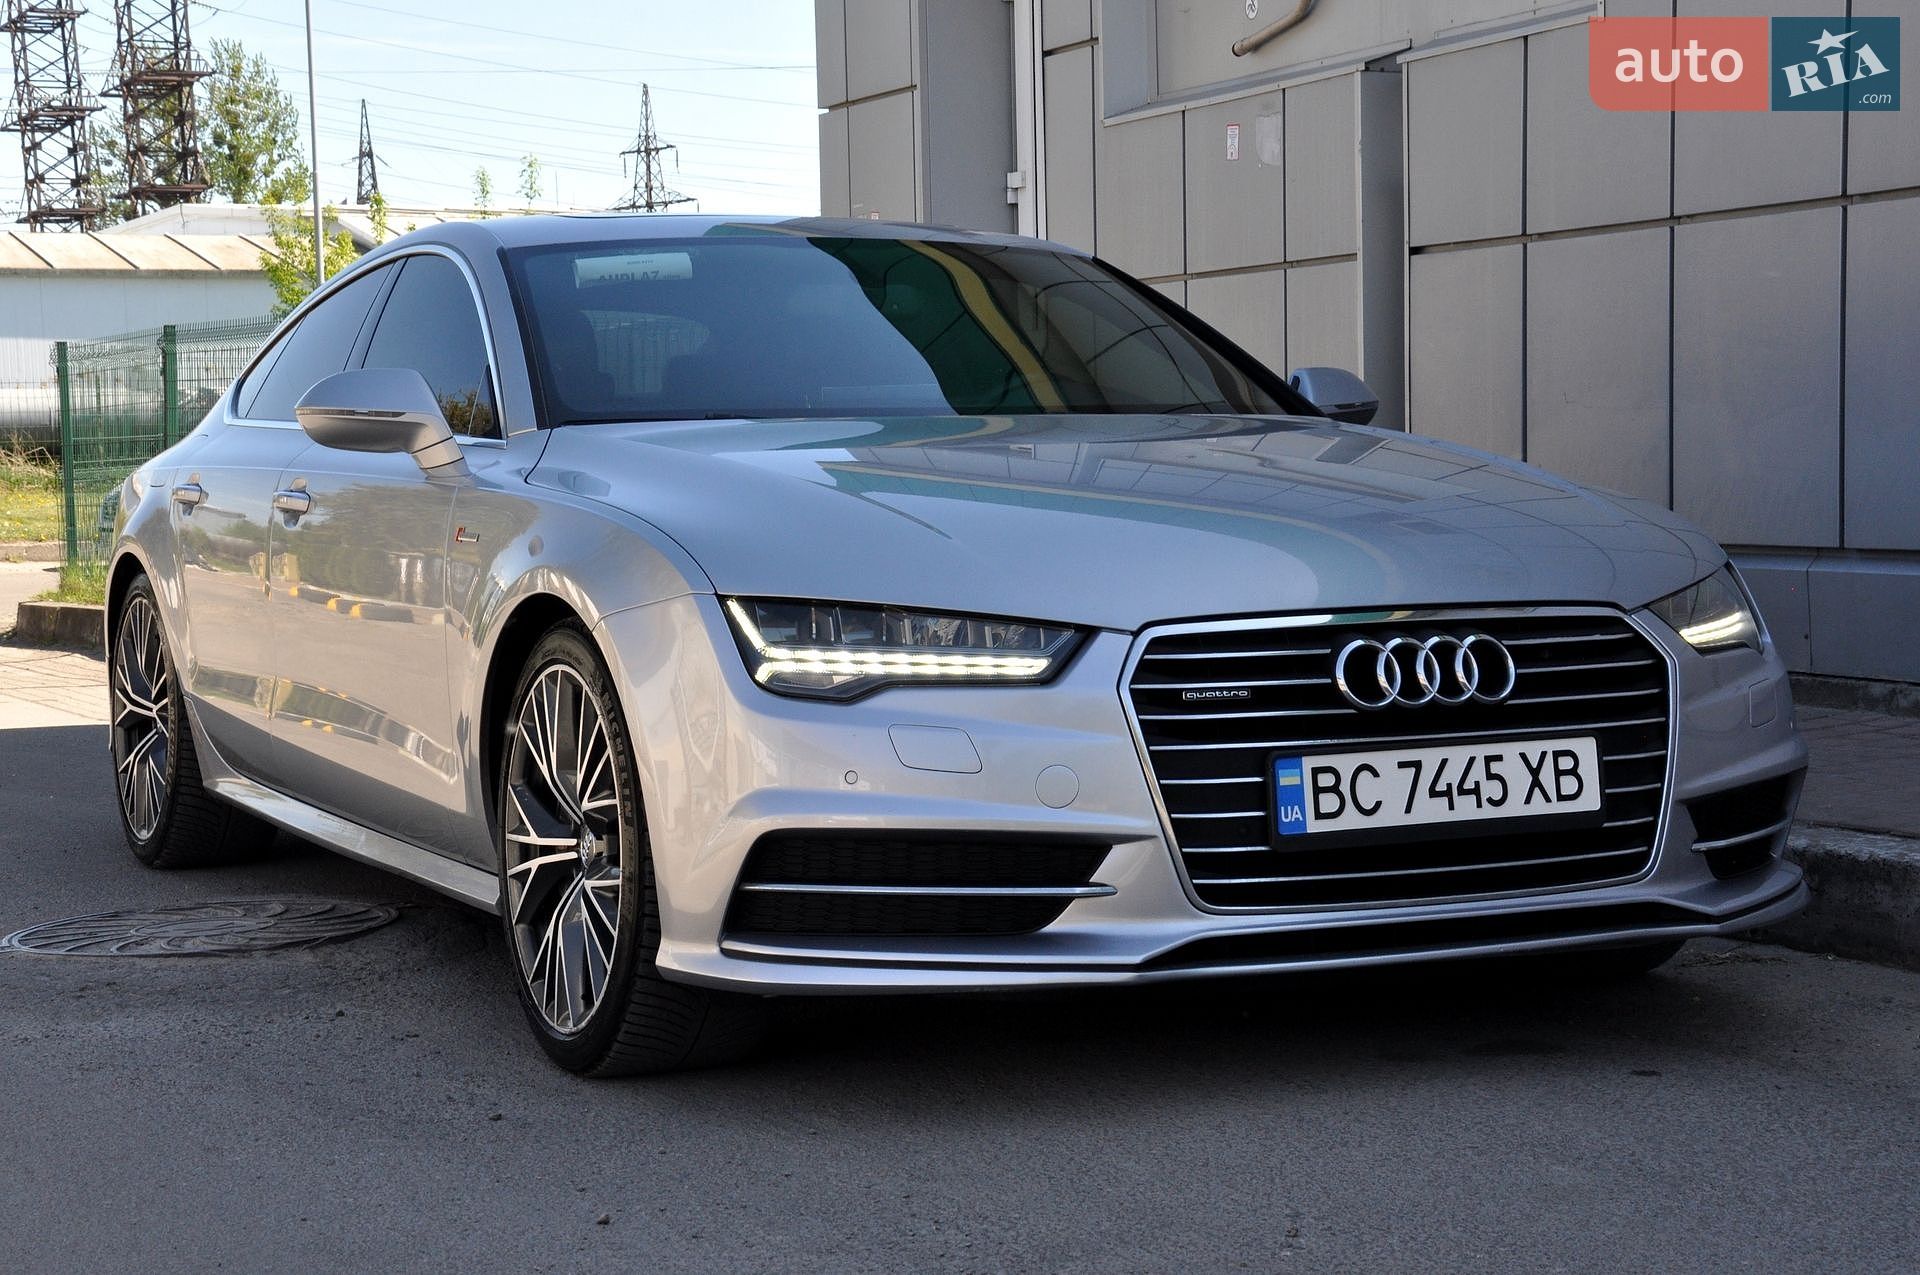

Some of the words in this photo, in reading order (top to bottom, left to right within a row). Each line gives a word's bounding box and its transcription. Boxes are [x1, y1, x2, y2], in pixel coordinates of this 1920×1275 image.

[1186, 690, 1249, 700] quattro
[1311, 763, 1383, 821] BC
[1397, 754, 1508, 814] 7445
[1518, 749, 1584, 805] XB
[1281, 804, 1303, 823] UA
